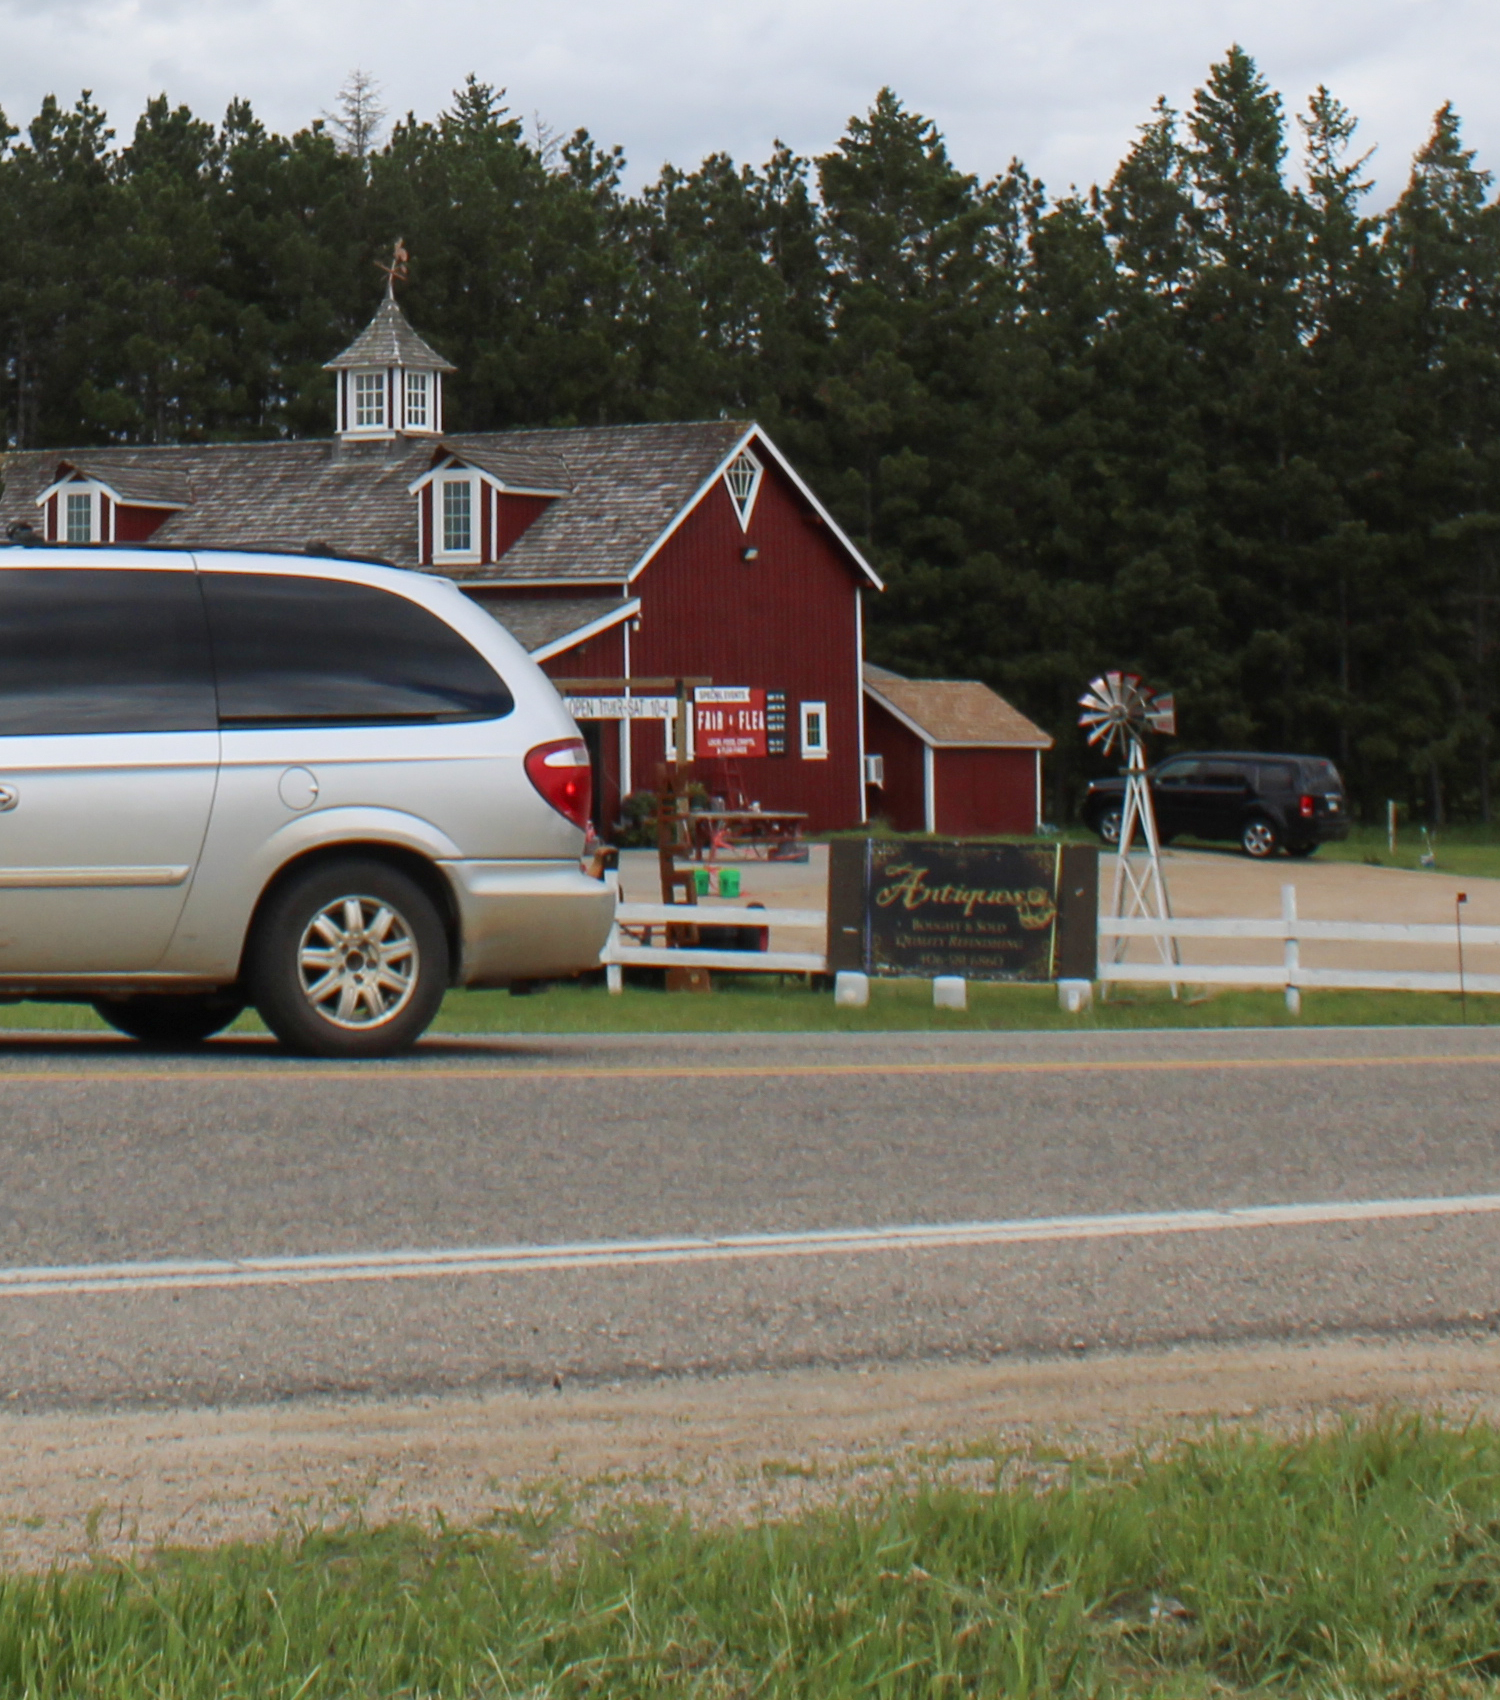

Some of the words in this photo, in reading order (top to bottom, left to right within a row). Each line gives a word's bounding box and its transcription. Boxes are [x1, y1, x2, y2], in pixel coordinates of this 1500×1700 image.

[569, 699, 594, 717] OPEN
[698, 710, 723, 731] FAIR
[738, 710, 764, 731] FLEA
[876, 862, 1026, 917] Antiques
